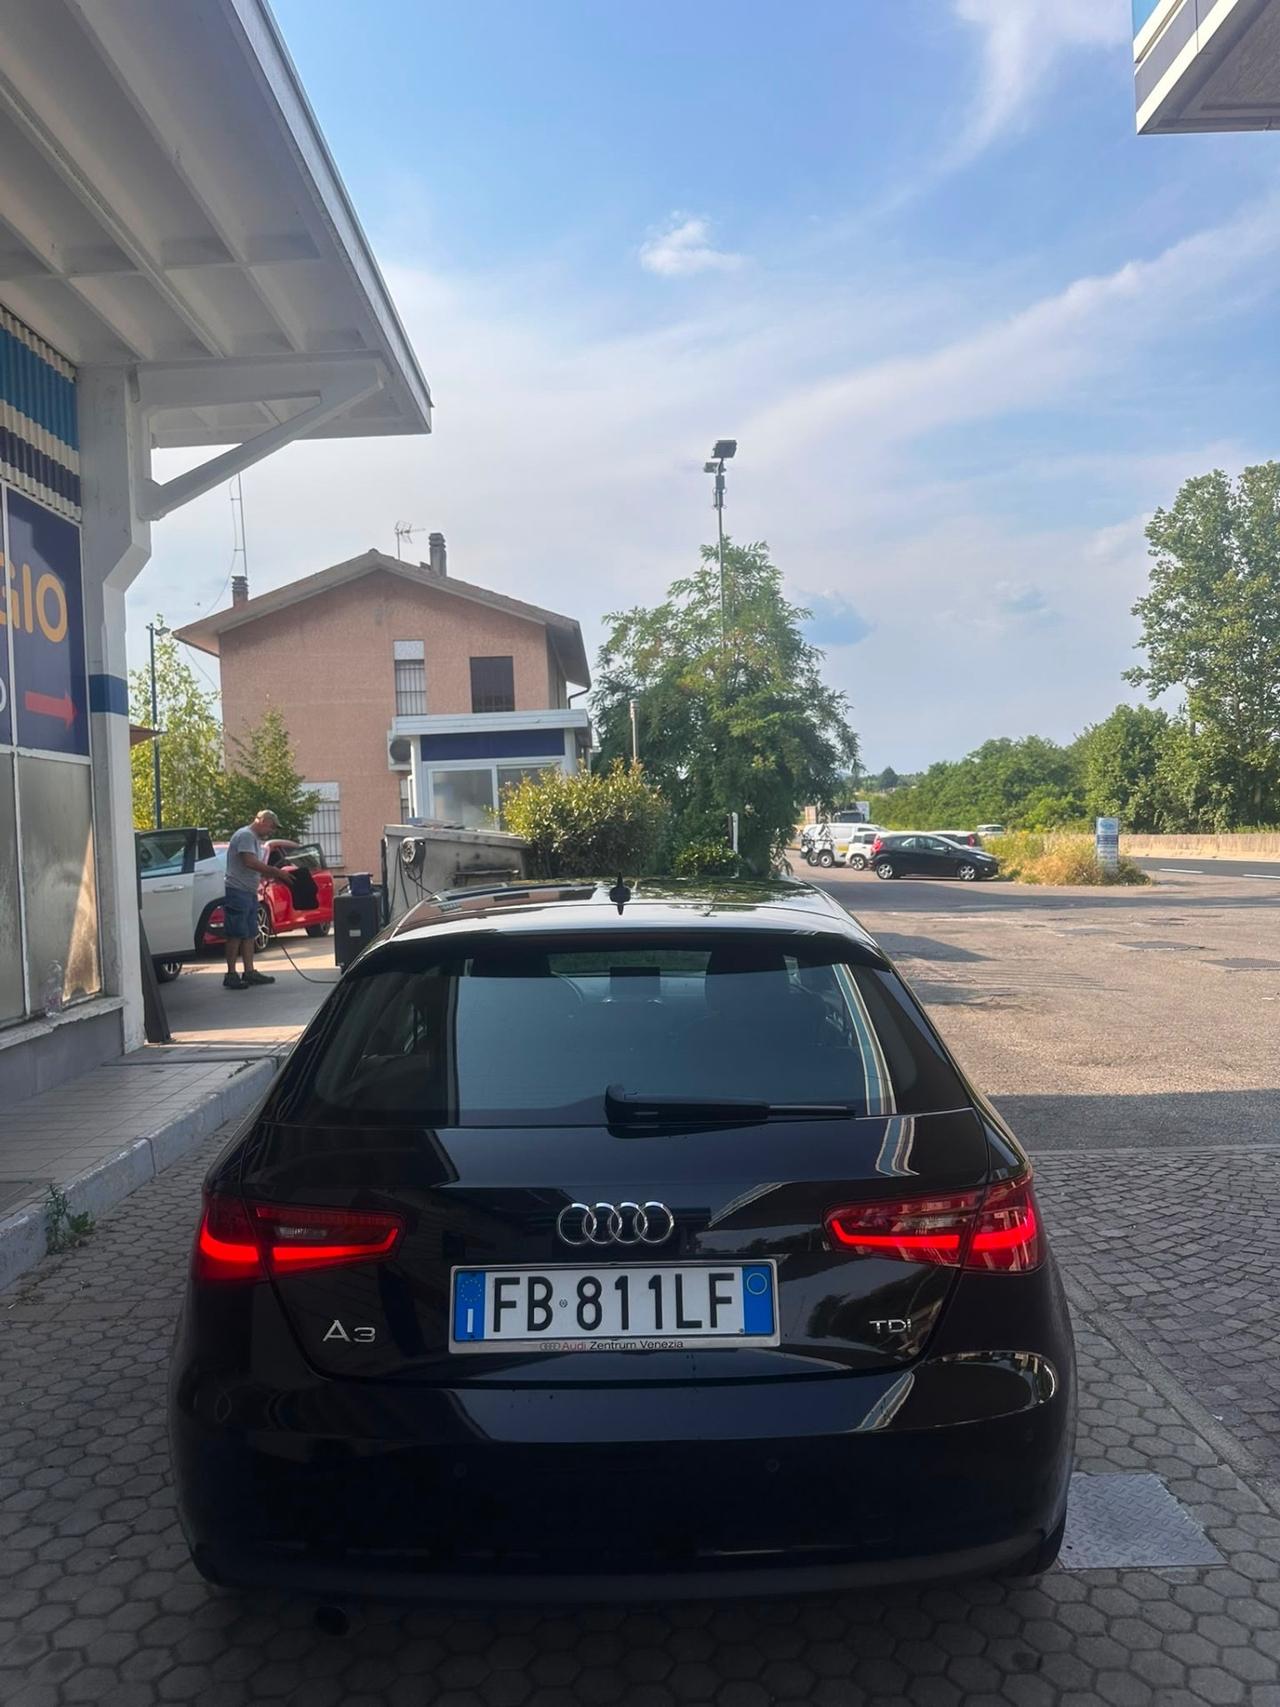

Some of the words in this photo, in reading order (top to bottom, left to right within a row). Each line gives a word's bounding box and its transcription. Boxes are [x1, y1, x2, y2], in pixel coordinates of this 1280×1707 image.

[493, 1276, 553, 1332] FB
[577, 1273, 734, 1331] 811LF
[323, 1319, 376, 1342] A3
[561, 1342, 586, 1351] Audi
[590, 1341, 637, 1351] Zentrum
[640, 1340, 684, 1349] Venezia
